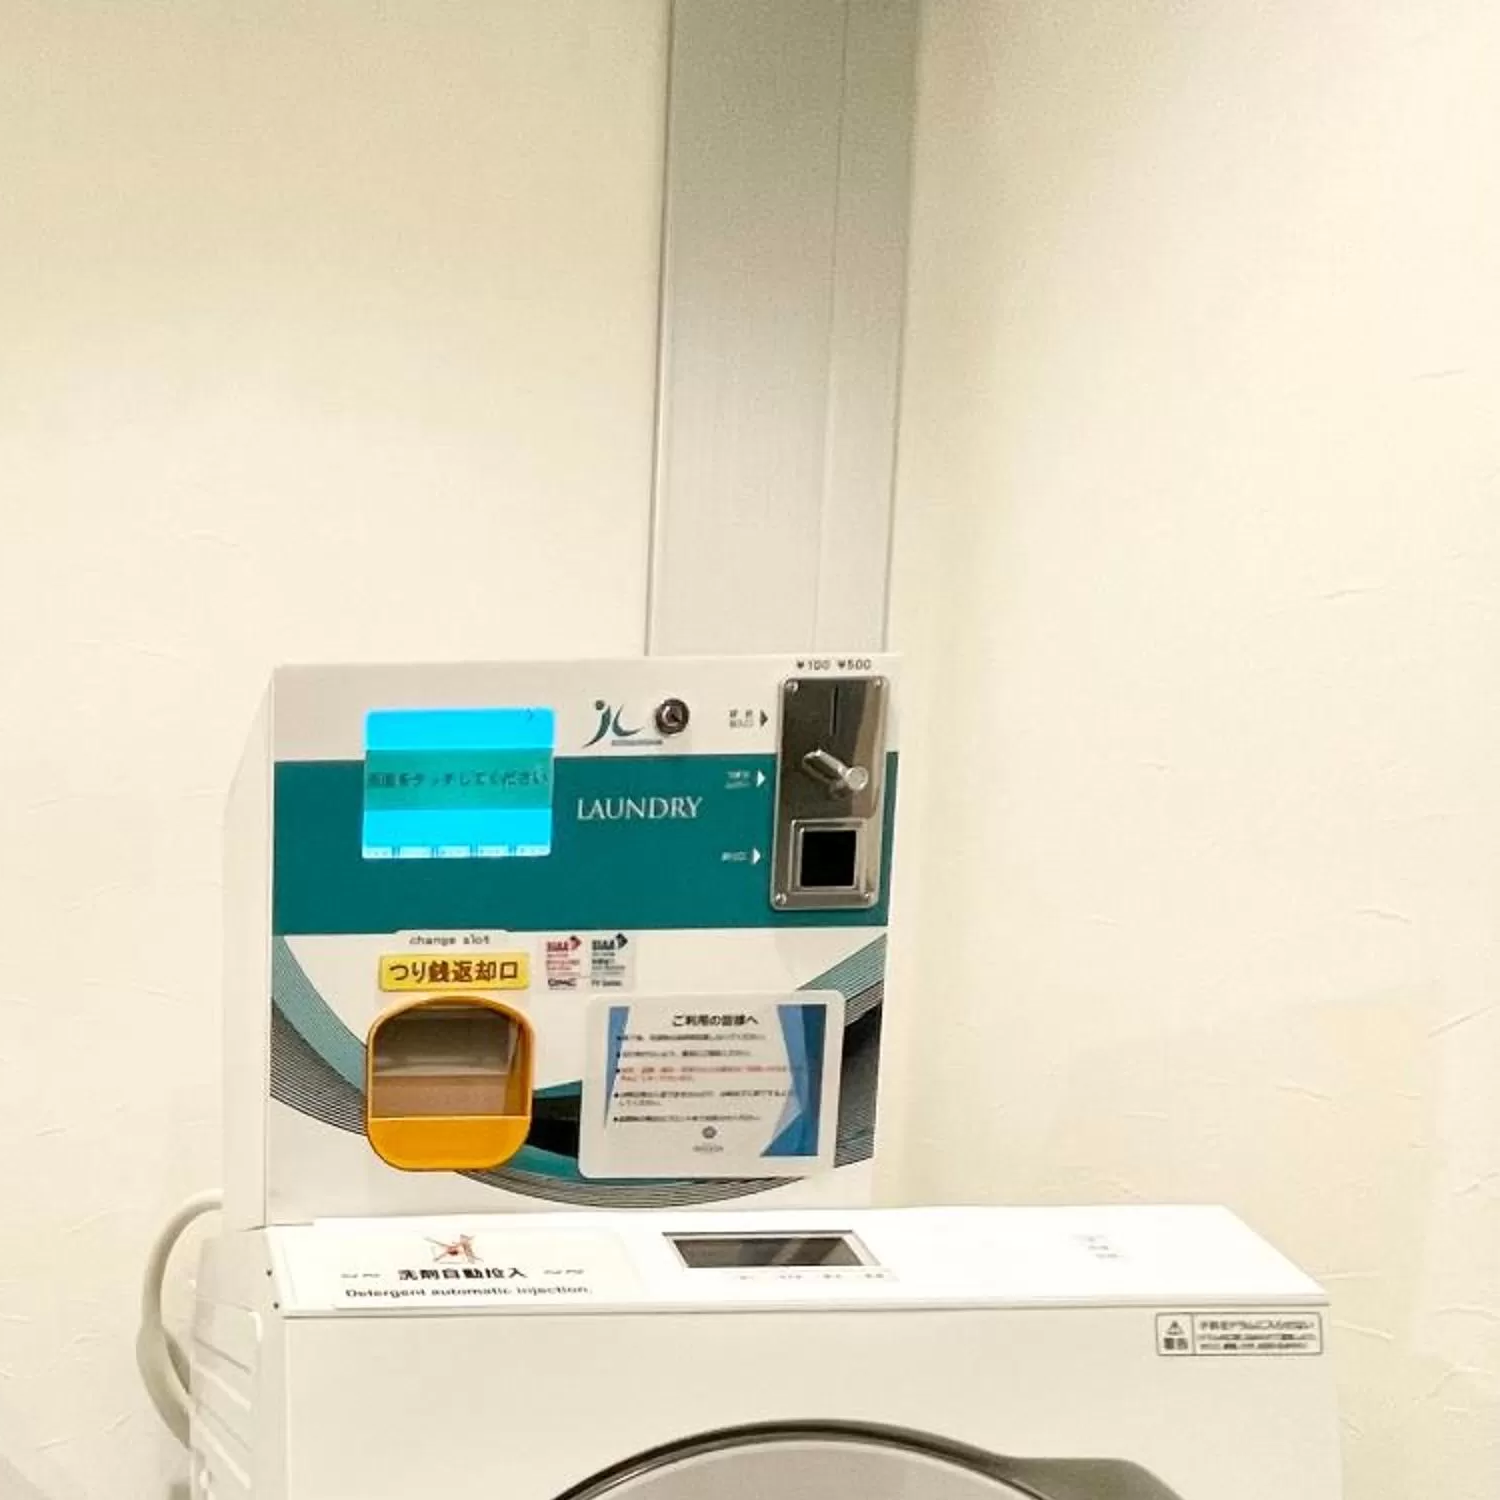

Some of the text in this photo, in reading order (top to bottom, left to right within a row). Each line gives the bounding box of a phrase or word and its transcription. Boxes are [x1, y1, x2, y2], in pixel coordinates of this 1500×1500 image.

[577, 796, 703, 820] LAUNDRY
[409, 933, 490, 946] change slot
[389, 960, 518, 983] つり銭返却口
[398, 1267, 528, 1281] 洗剤自動投入
[345, 1288, 426, 1298] Detergent
[431, 1286, 511, 1296] automatic
